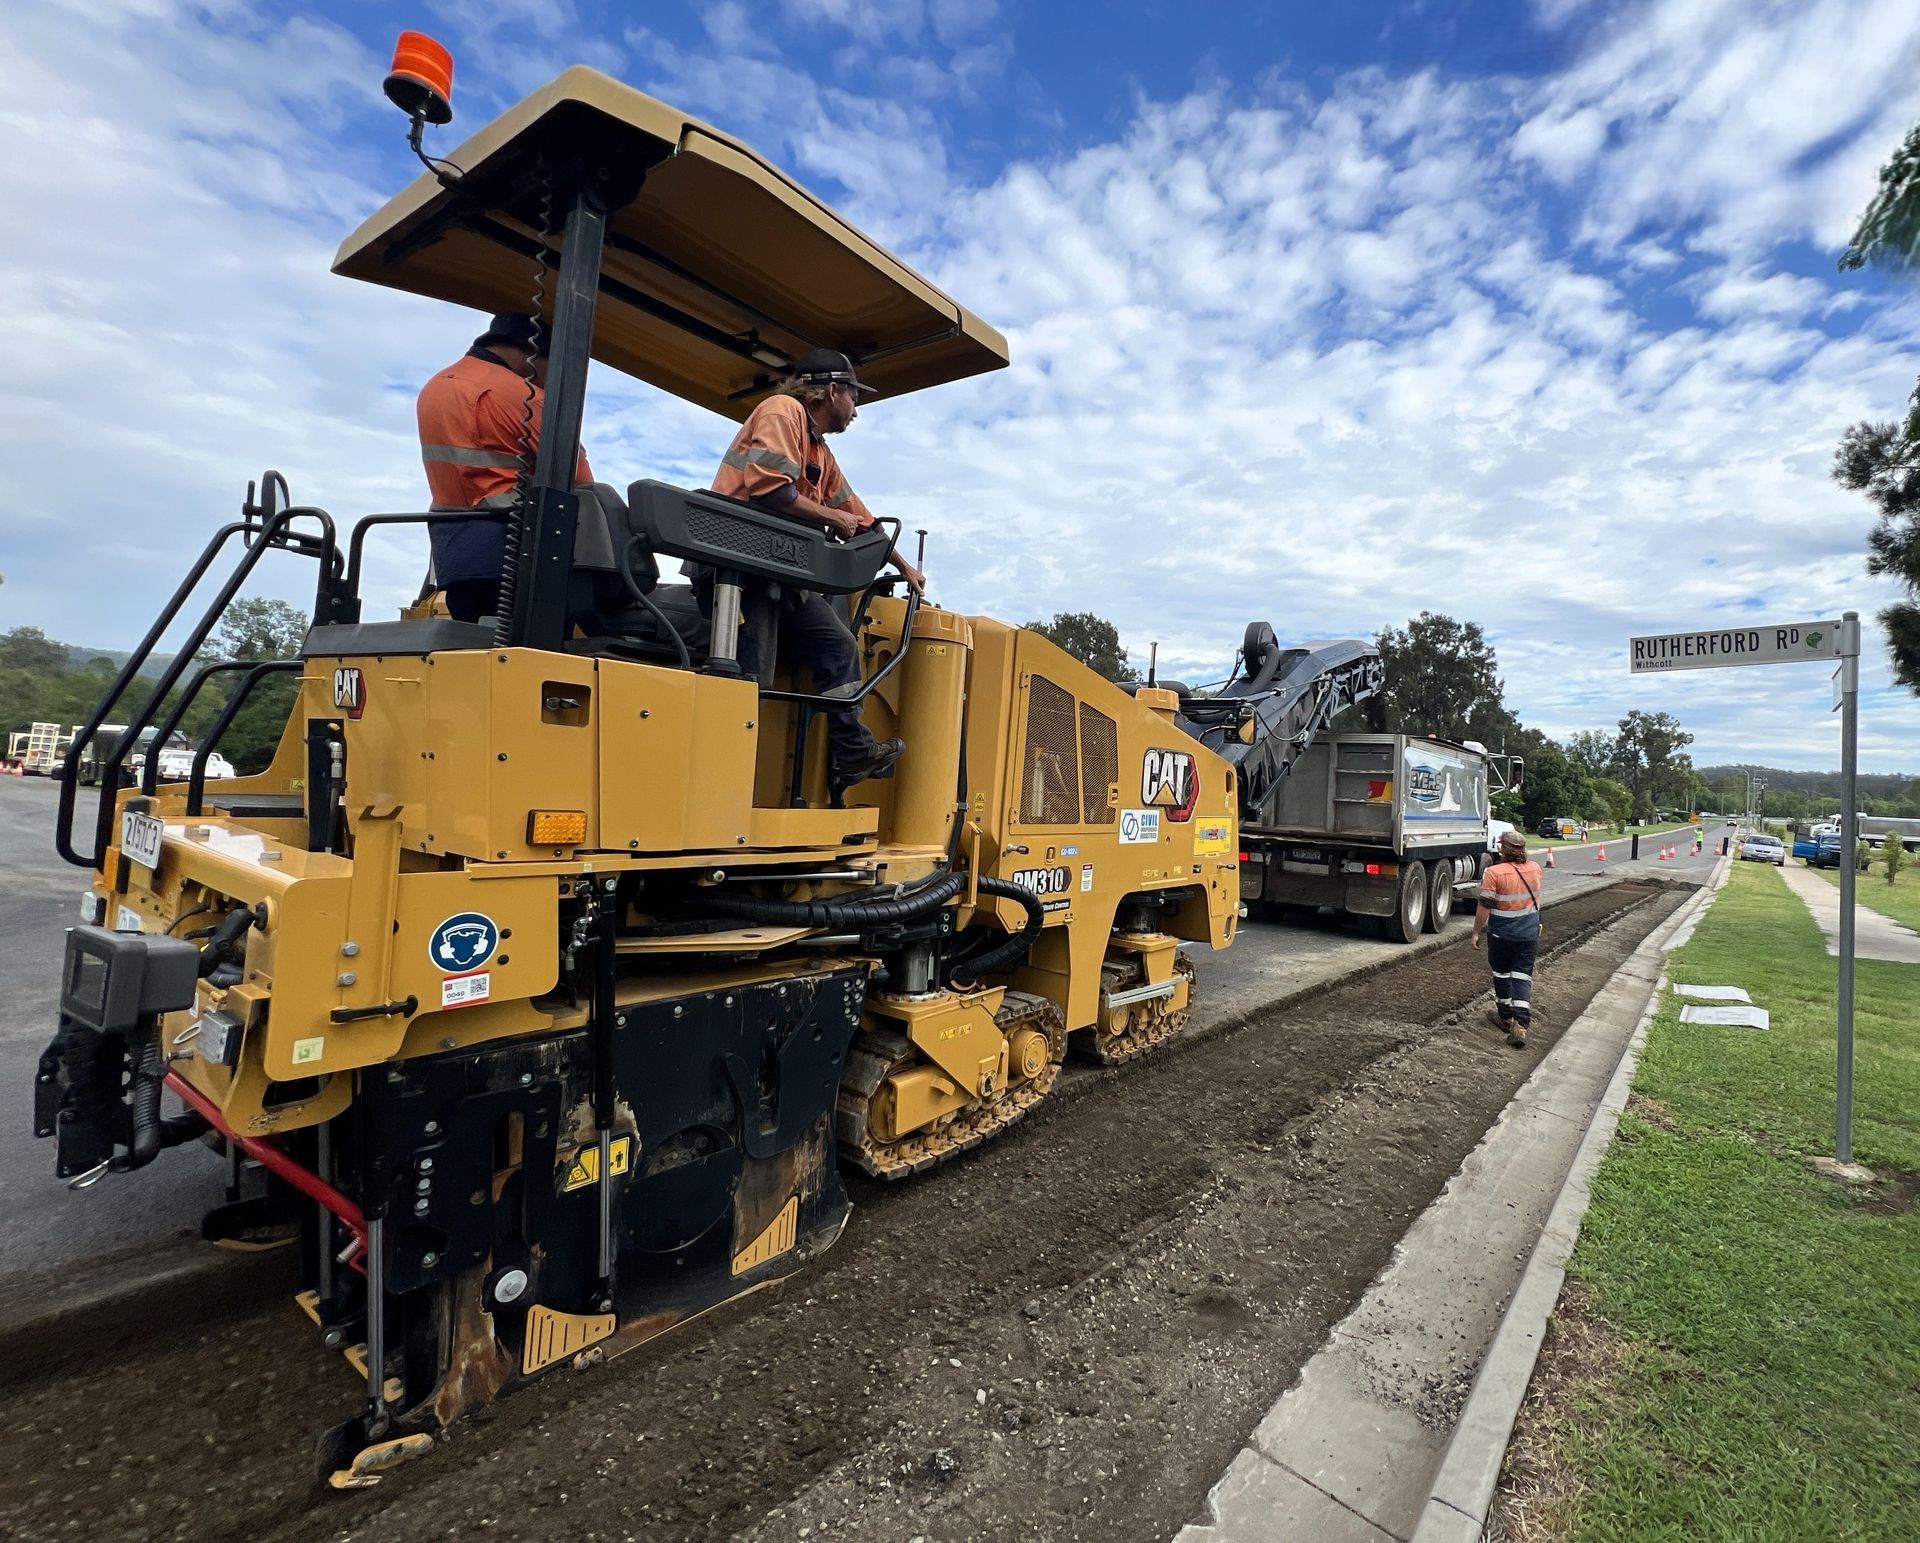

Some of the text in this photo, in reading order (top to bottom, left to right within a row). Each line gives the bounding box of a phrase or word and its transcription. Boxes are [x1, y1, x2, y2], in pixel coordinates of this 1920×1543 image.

[770, 535, 801, 563] CAT
[1635, 628, 1799, 659] RUTHERFORD RD
[1636, 660, 1672, 669] Withcott
[334, 669, 359, 707] CAT
[1142, 749, 1189, 806] CAT
[1141, 814, 1158, 826] CIVIL
